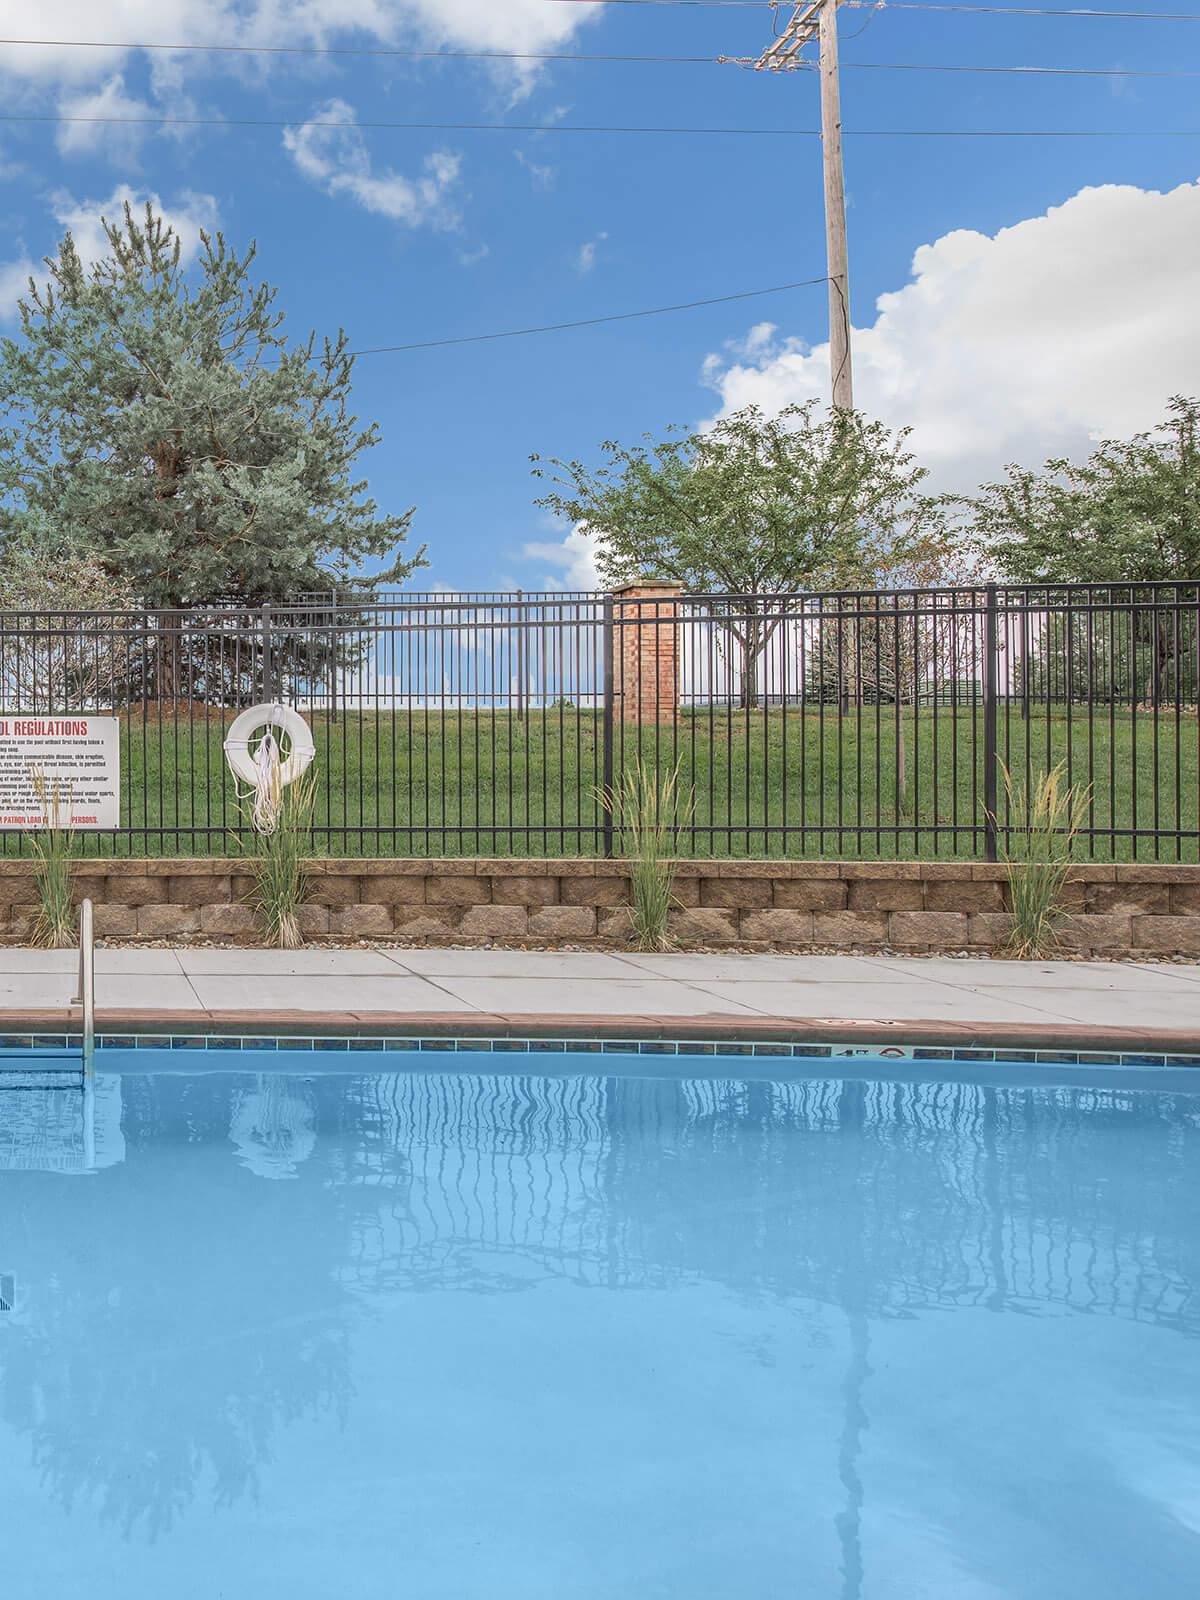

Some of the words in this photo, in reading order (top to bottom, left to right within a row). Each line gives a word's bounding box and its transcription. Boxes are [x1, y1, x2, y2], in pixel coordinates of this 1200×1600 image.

[14, 721, 88, 736] REGULATIONS
[3, 816, 26, 824] PATRON
[27, 816, 41, 824] LOAD
